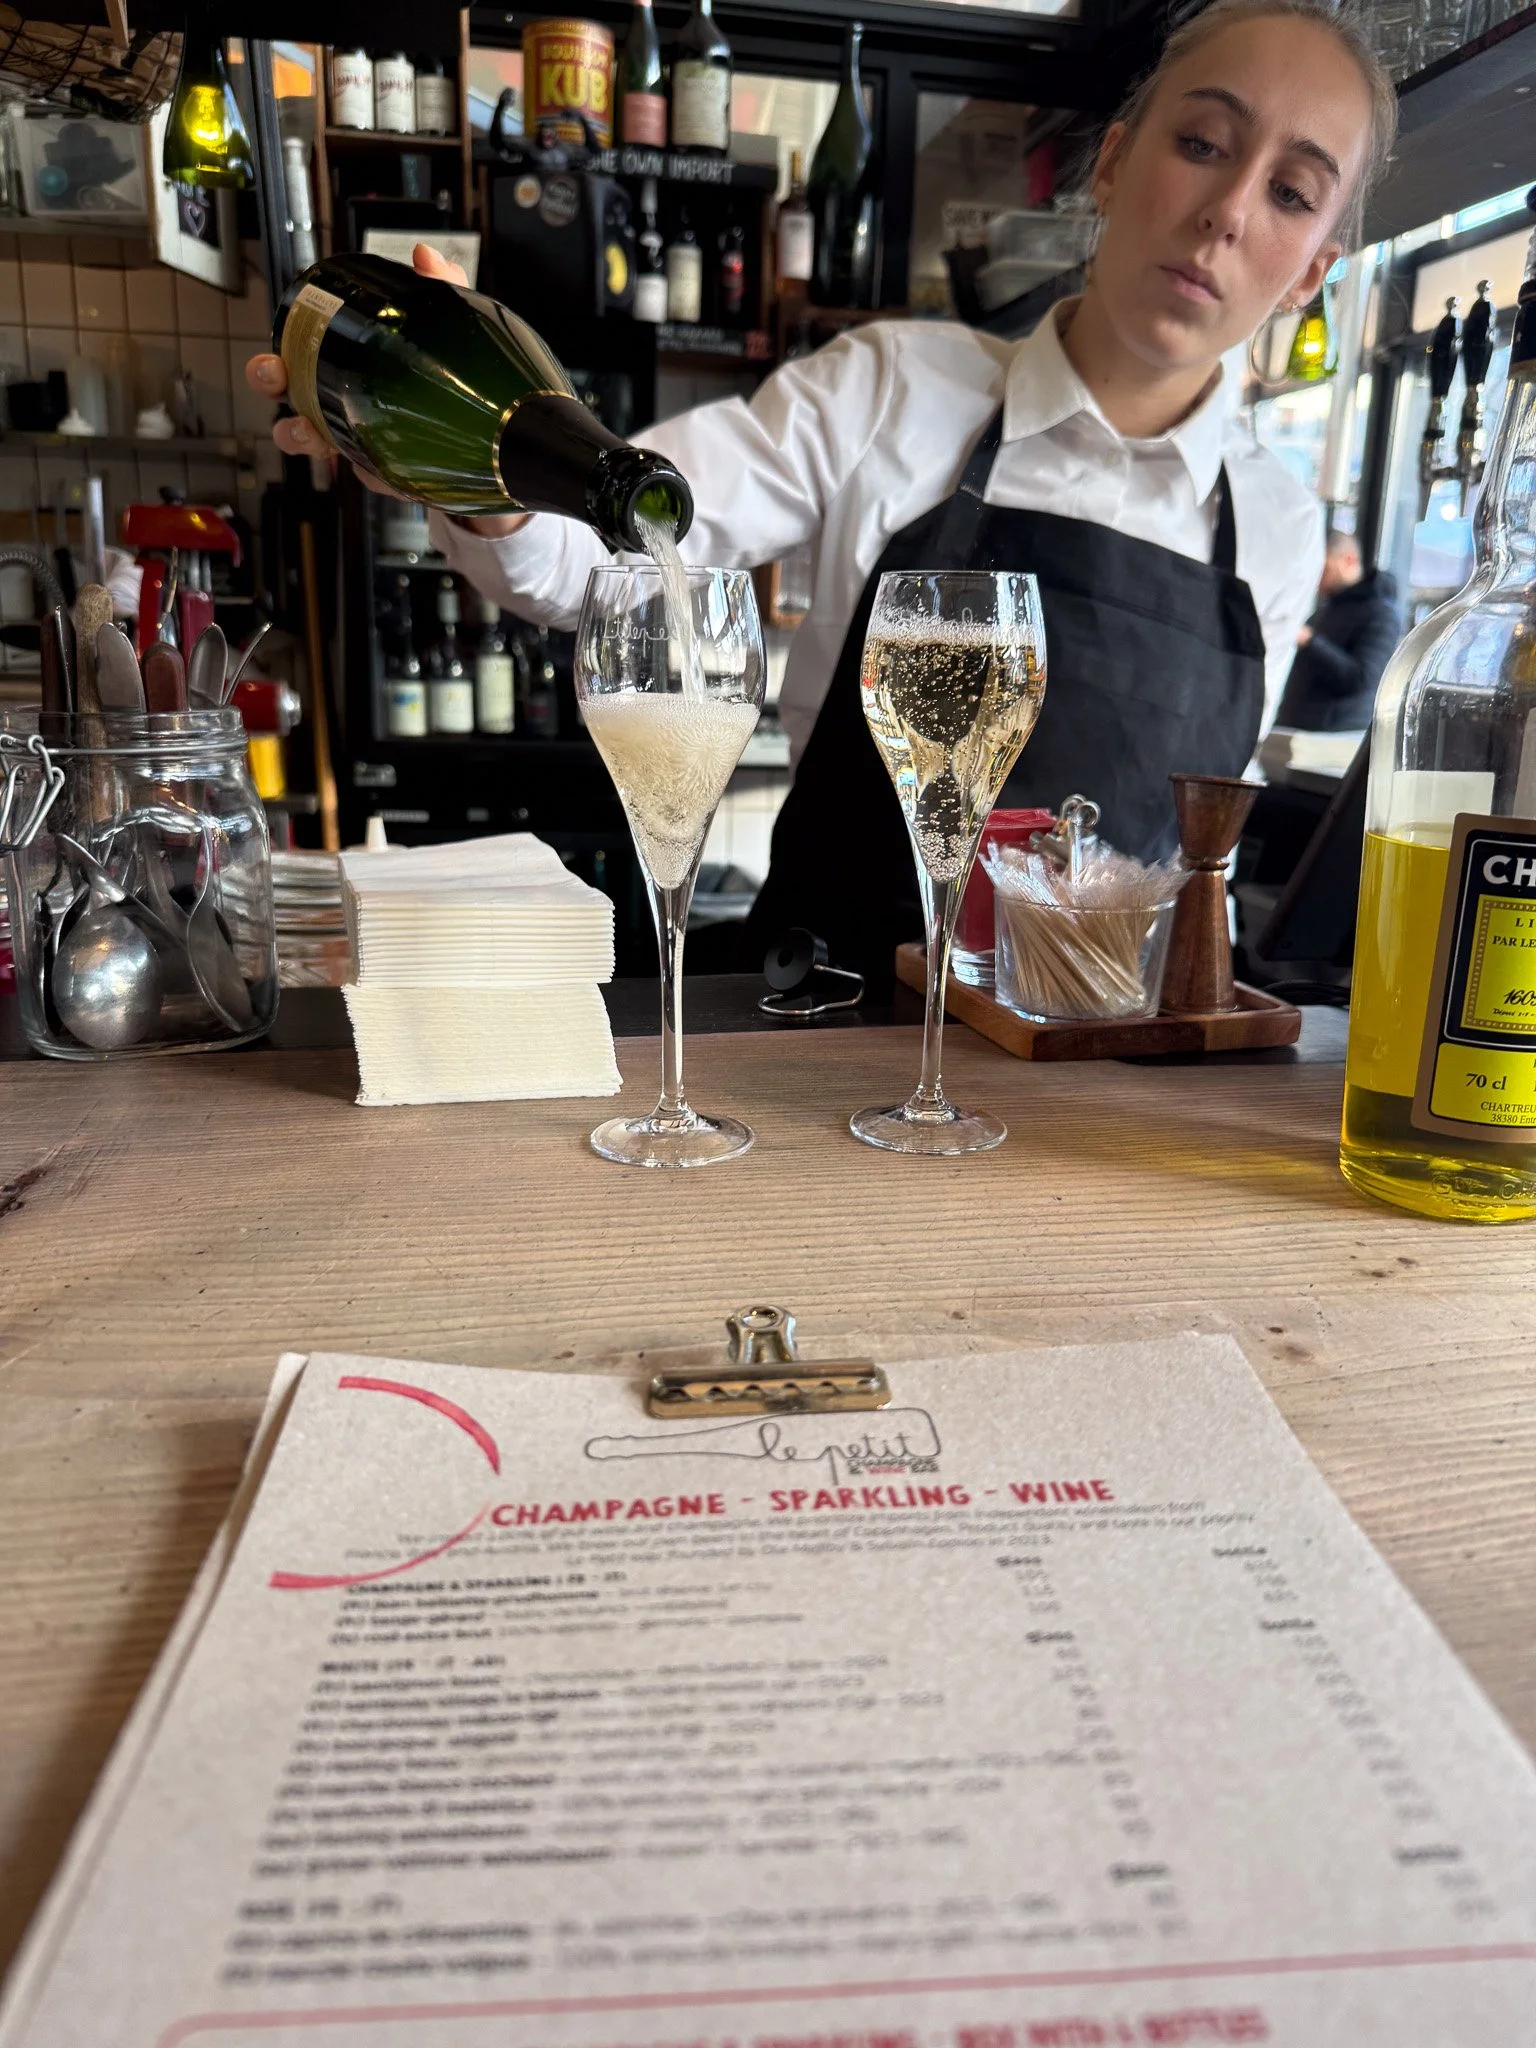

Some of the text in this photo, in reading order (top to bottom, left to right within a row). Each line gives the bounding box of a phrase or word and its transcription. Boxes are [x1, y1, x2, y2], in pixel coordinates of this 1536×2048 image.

[541, 63, 607, 113] KUB
[621, 149, 664, 177] OWN
[668, 155, 734, 185] IMPORT
[1492, 935, 1517, 948] PAR
[1466, 1072, 1507, 1091] 70 cl
[1490, 1113, 1518, 1124] 38380
[490, 1493, 726, 1527] CHAMPAGNE
[769, 1483, 971, 1512] SPARKLING
[1009, 1479, 1115, 1504] WINE
